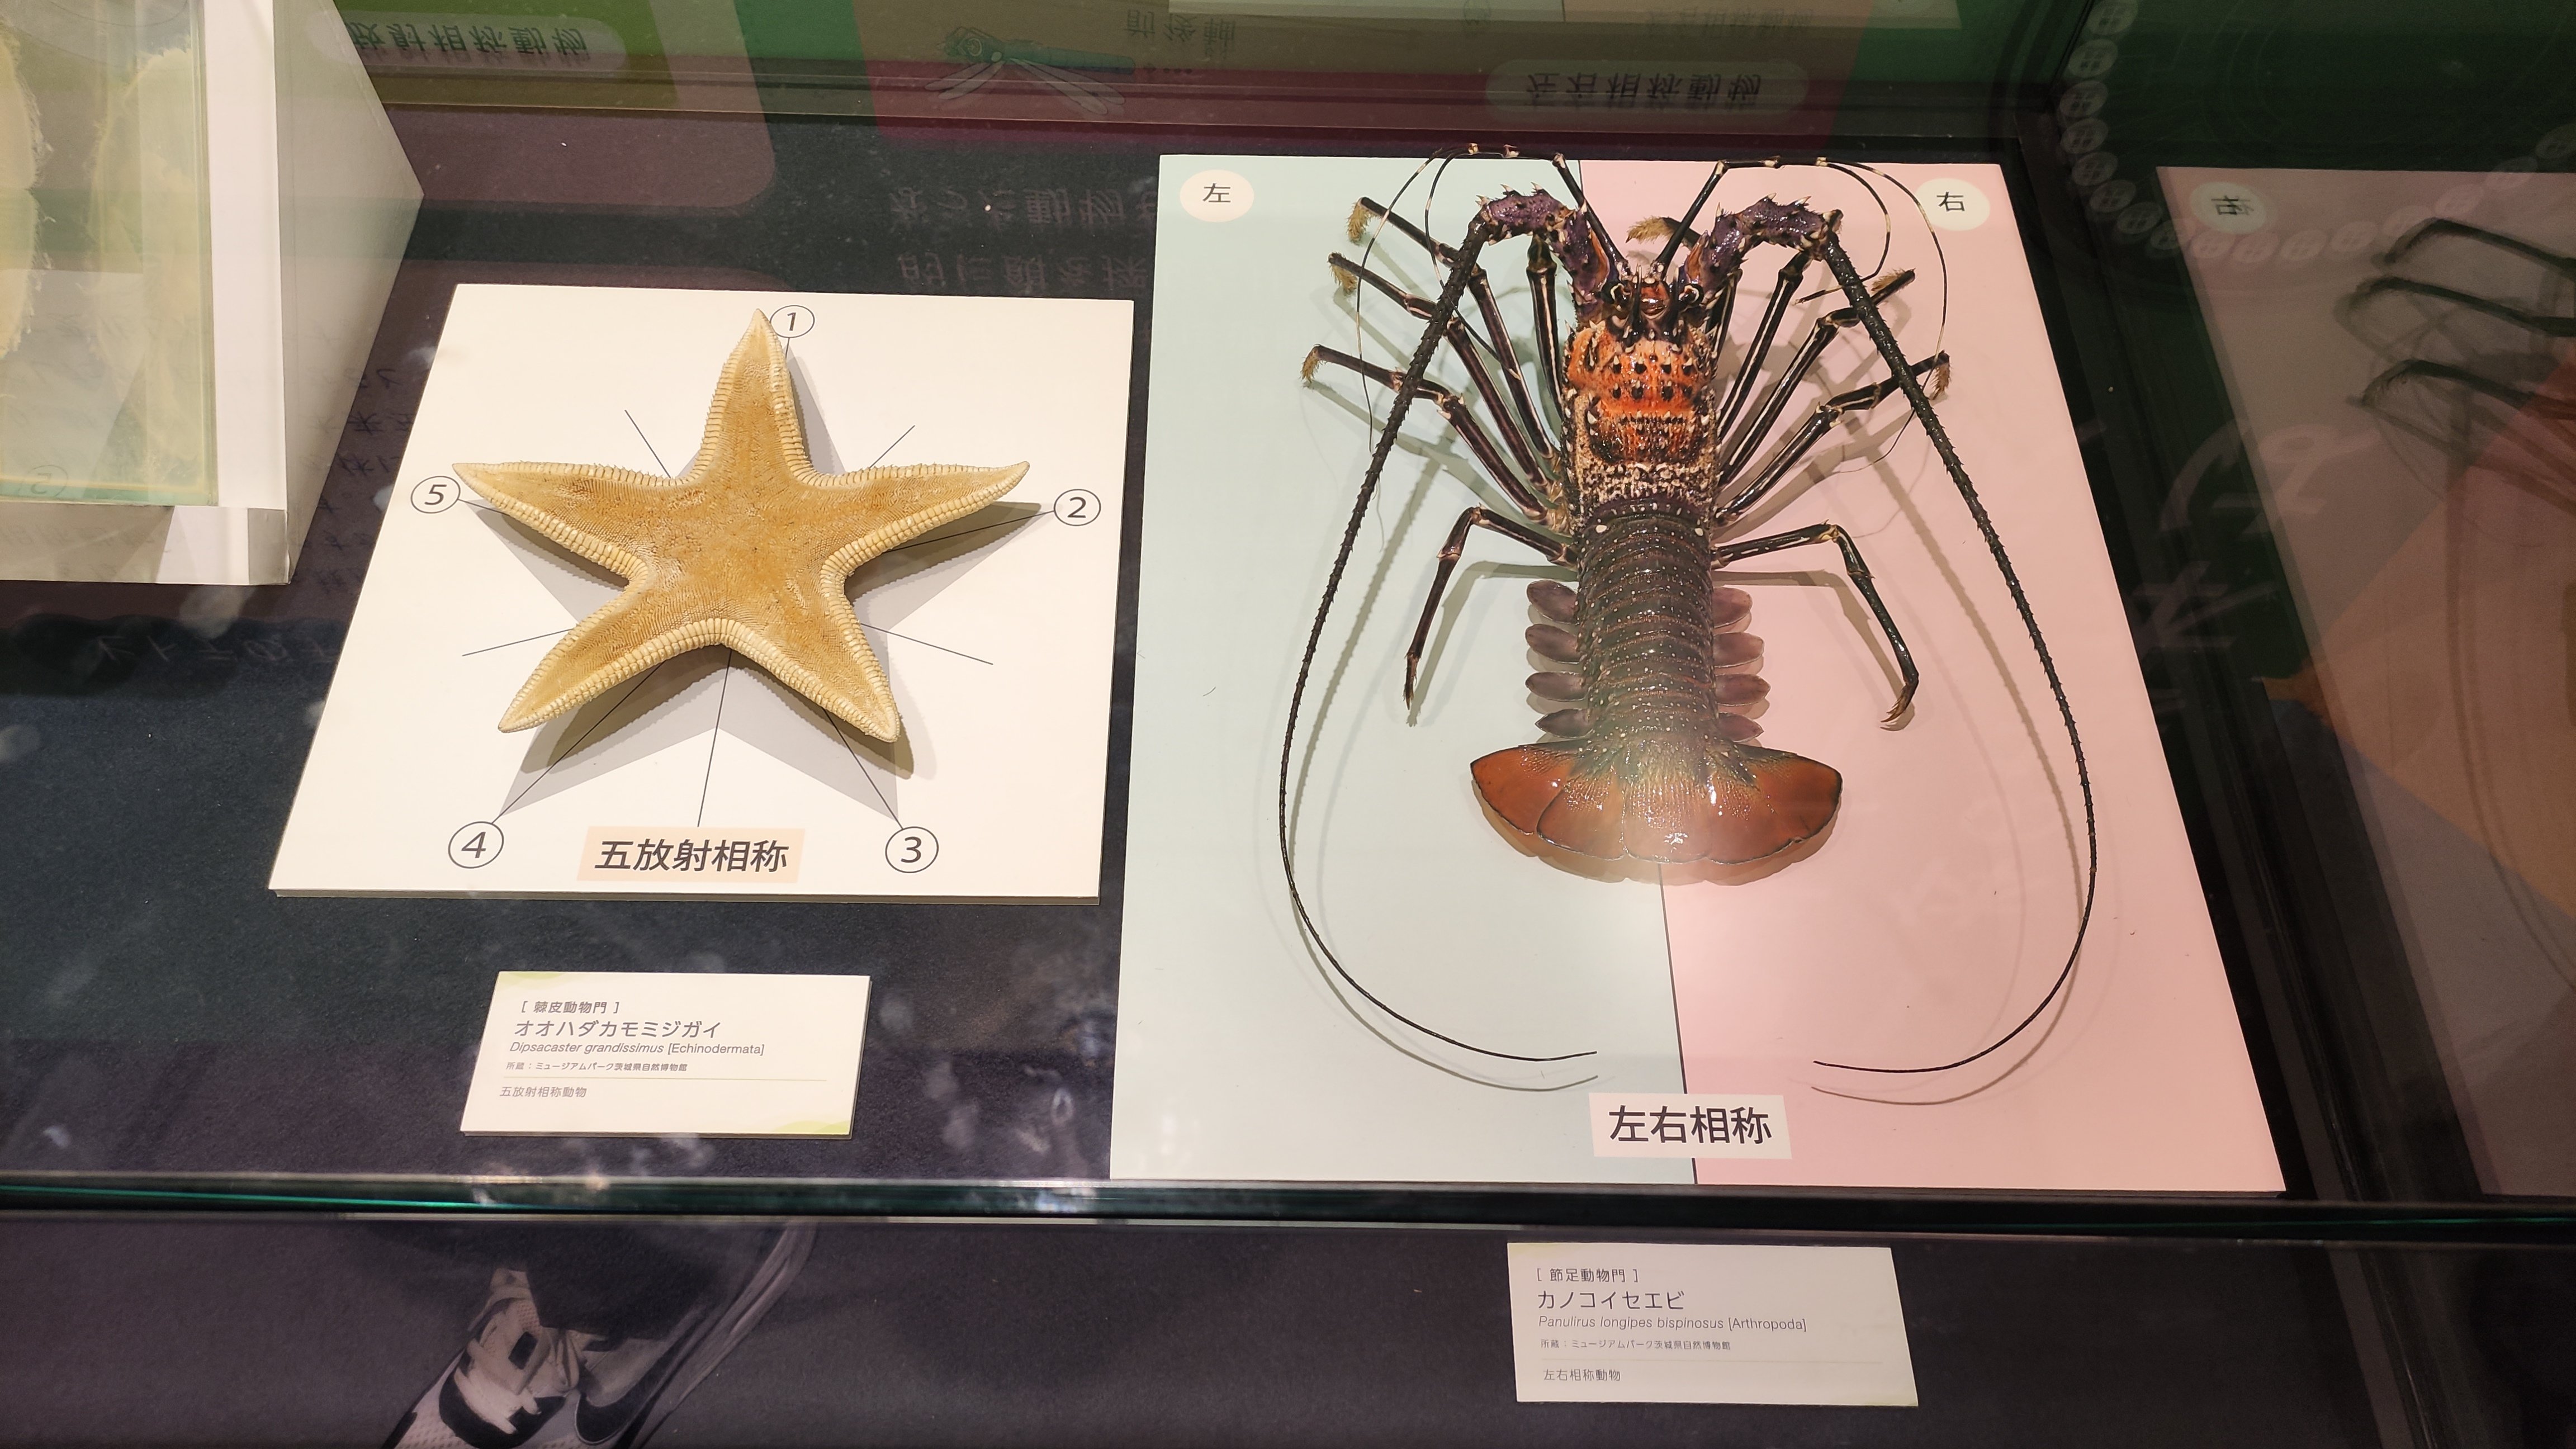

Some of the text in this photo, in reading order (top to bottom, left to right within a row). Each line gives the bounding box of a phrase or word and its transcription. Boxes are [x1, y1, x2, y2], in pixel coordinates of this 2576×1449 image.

[1202, 183, 1231, 203] 左
[1936, 191, 1965, 212] 右
[594, 838, 789, 873] 五放射相称
[514, 1020, 722, 1039] オオハダカモミジガイ
[509, 1041, 765, 1056] Dipsacaster grandissimus [Echinodermata]
[499, 1086, 587, 1098] 五放射相称動物
[1608, 1105, 1772, 1144] 左右相称
[1538, 1290, 1685, 1310] カノコイセエビ
[1538, 1315, 1807, 1333] Panulirus longipes bispinosus [Arthropoda]
[1543, 1368, 1621, 1381] 左右相称動物
